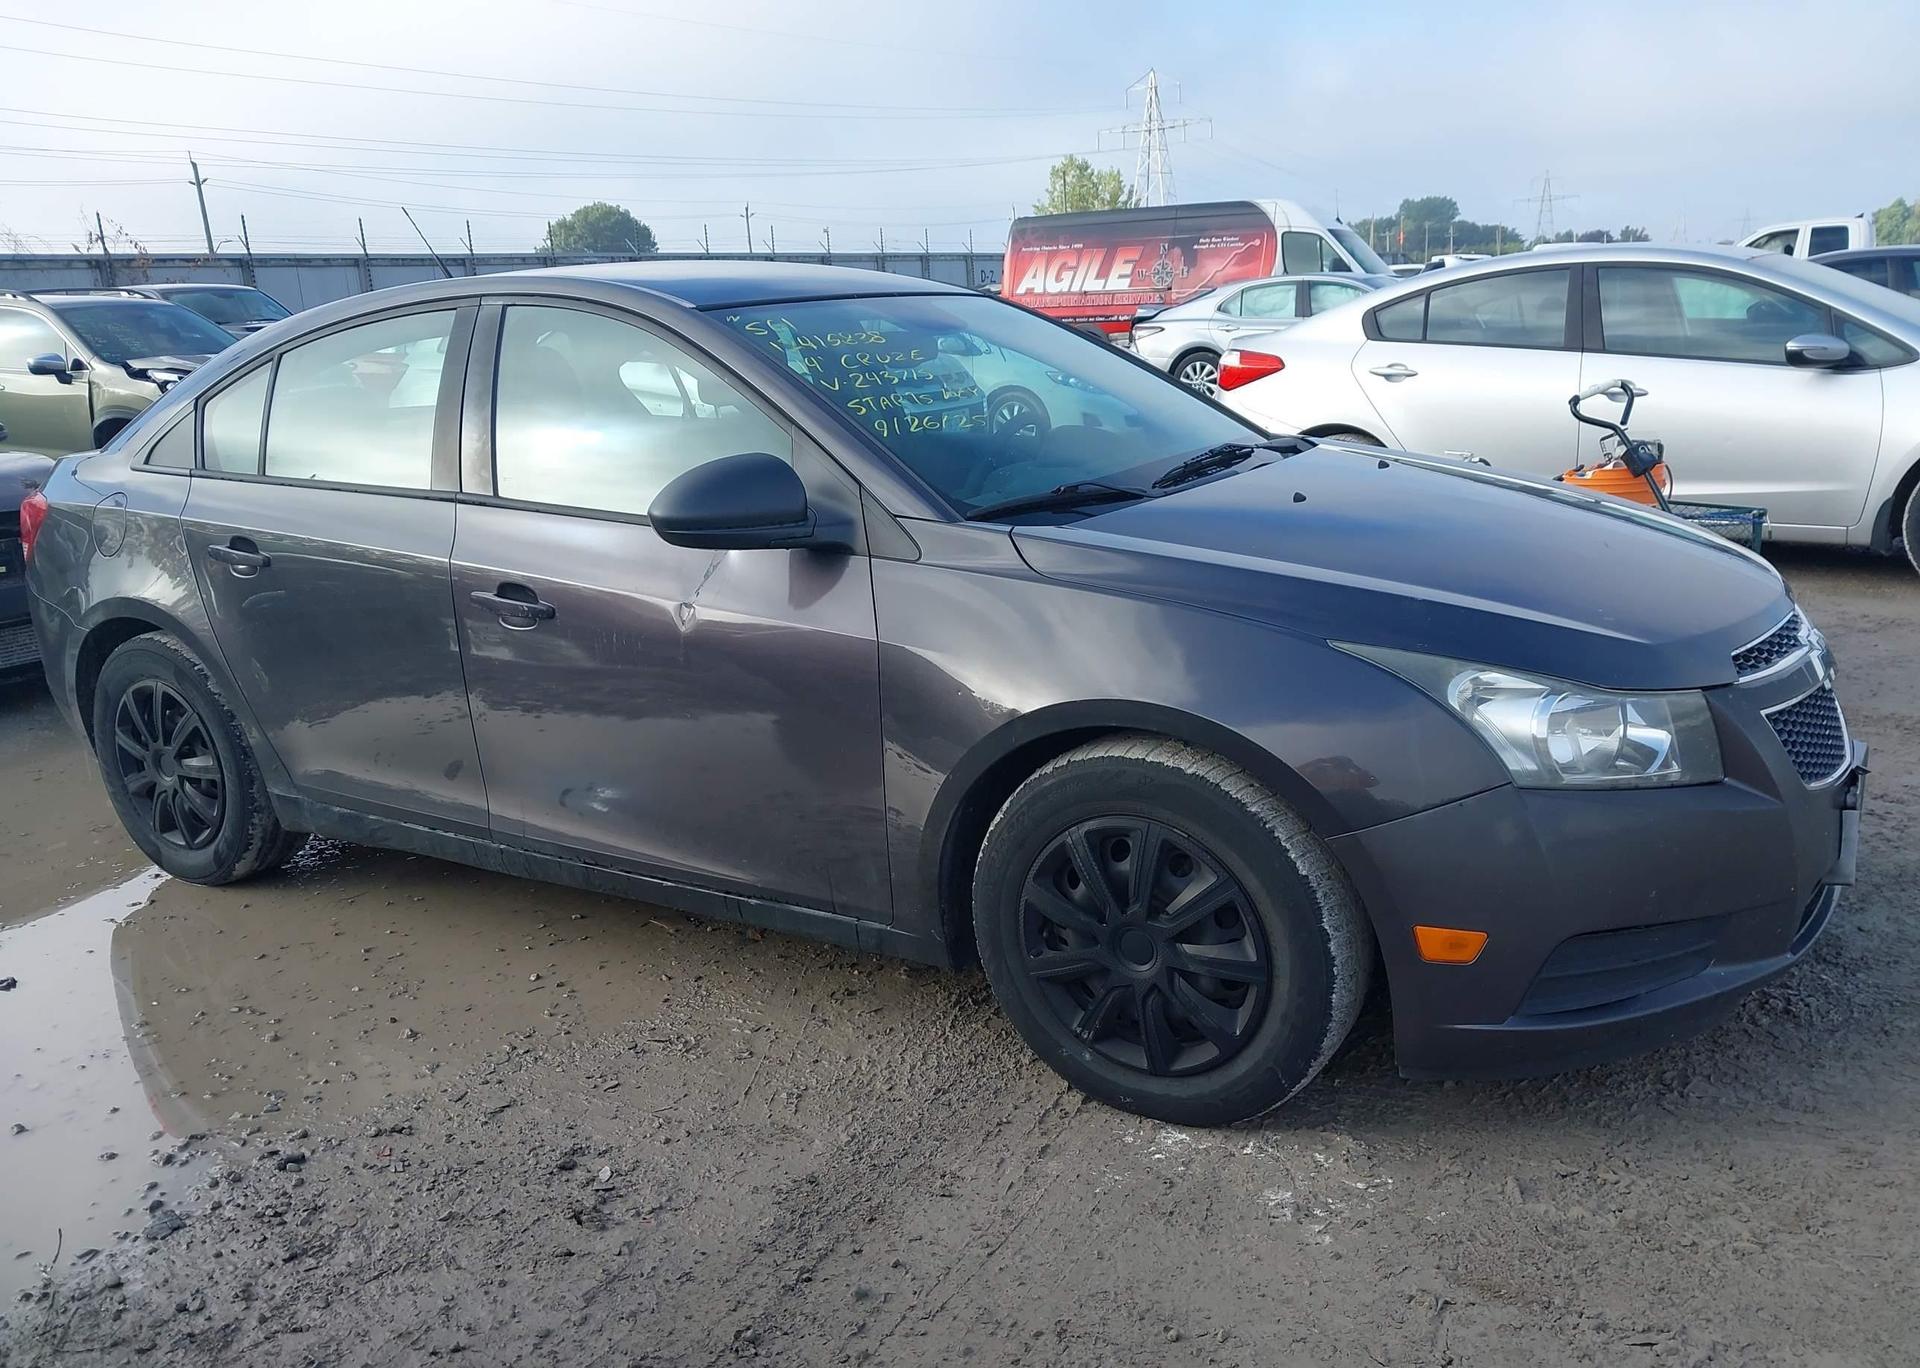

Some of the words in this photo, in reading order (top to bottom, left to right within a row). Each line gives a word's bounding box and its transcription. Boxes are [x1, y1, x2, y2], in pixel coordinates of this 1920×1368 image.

[1160, 243, 1169, 254] N
[1016, 246, 1144, 295] AGILE
[841, 349, 926, 370] CRUZE
